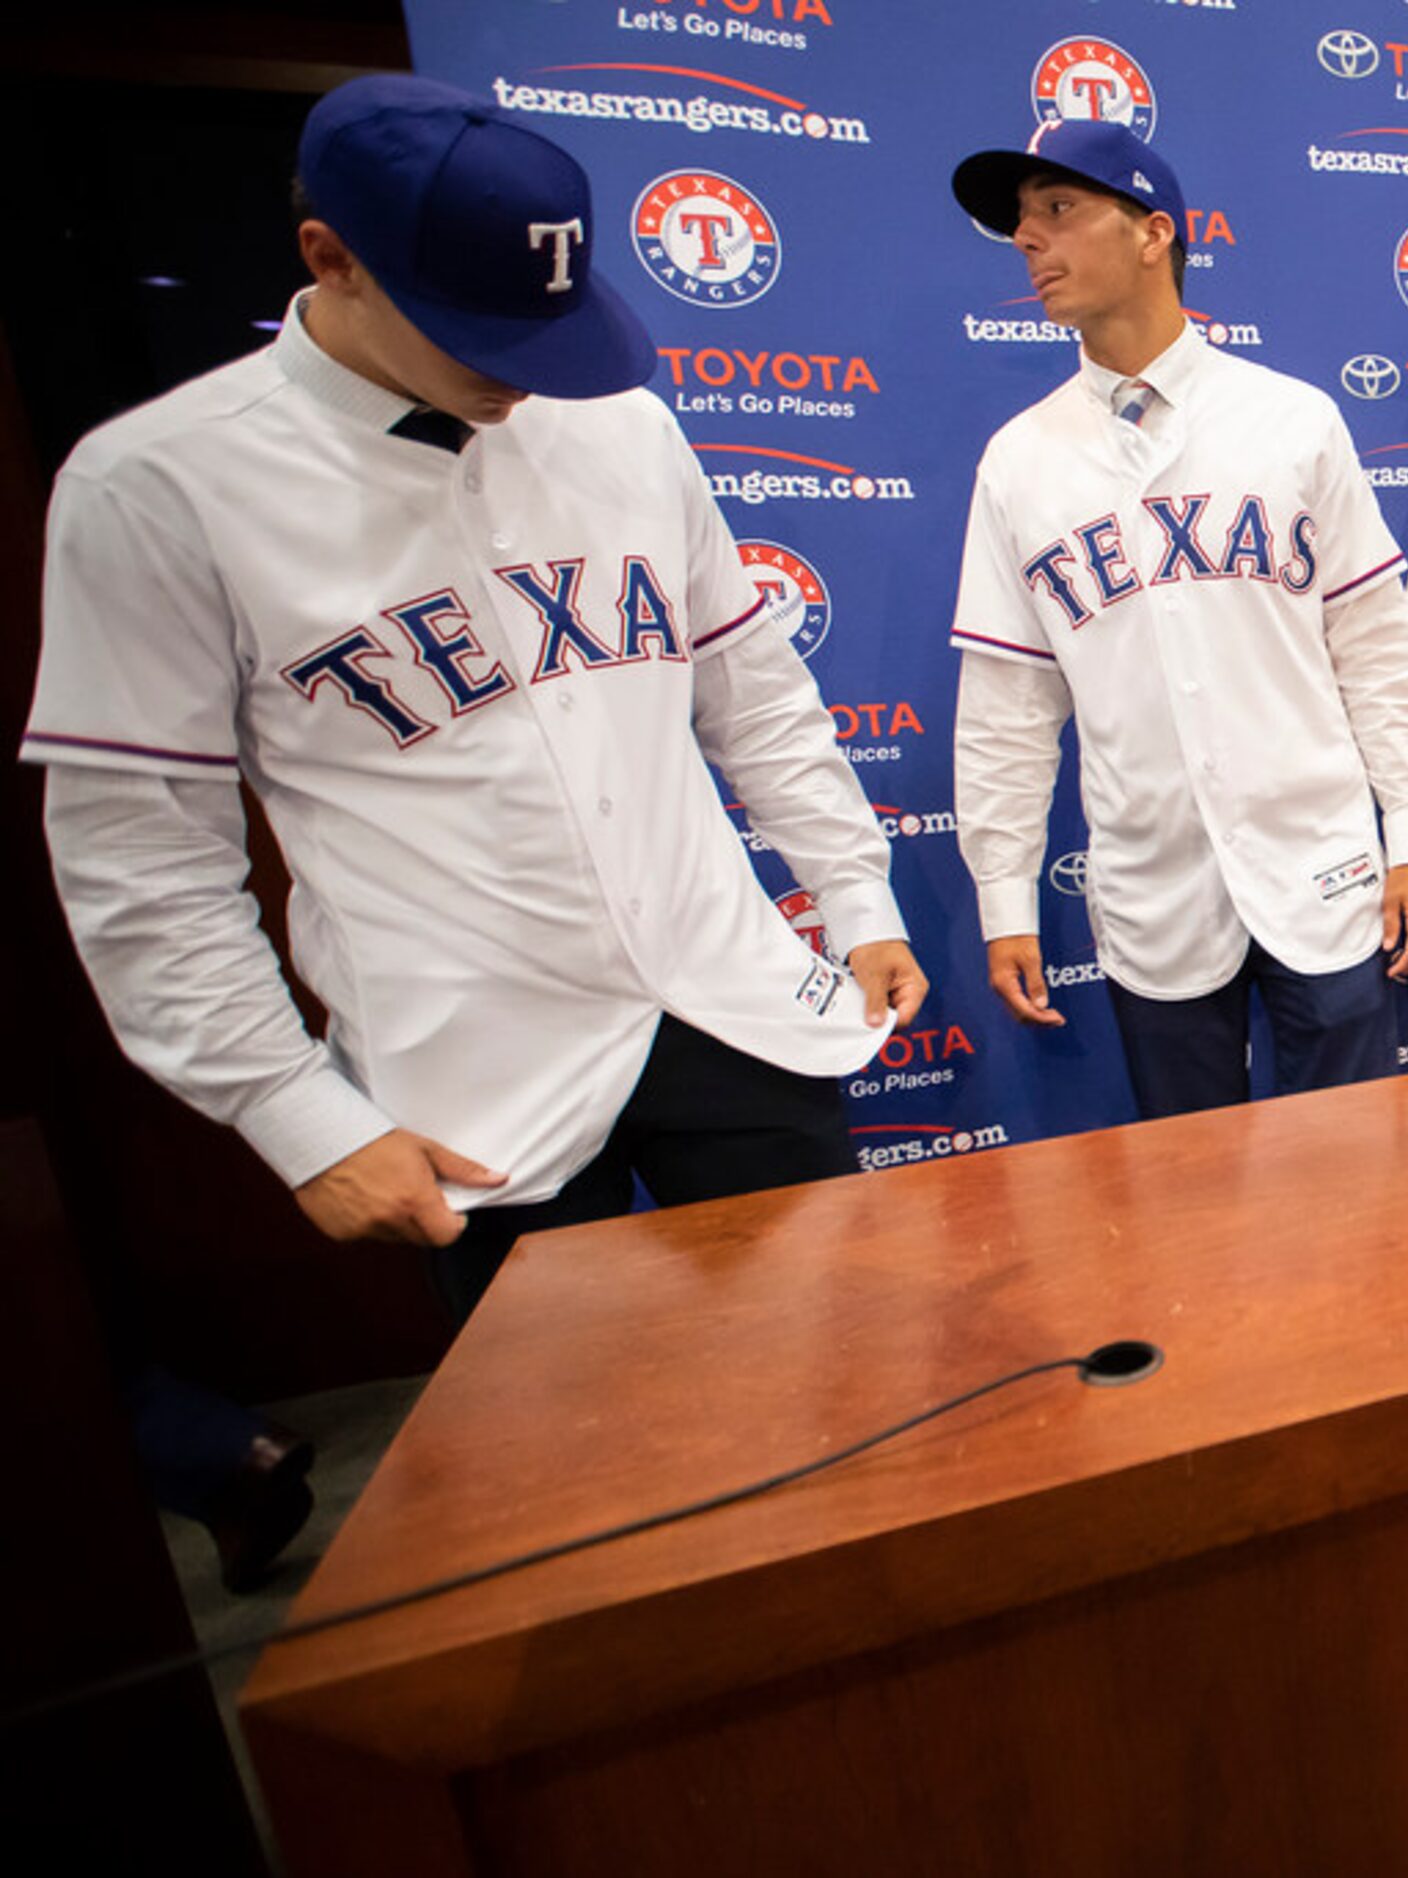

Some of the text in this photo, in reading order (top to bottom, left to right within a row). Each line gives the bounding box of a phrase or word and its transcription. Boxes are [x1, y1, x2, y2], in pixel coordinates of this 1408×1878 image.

[617, 7, 677, 32] Let's
[684, 13, 721, 37] Go
[725, 18, 808, 50] Places
[1047, 44, 1135, 79] TEXAS
[493, 75, 870, 144] texasrangers.com
[650, 178, 754, 217] TEXAS
[527, 217, 584, 294] T
[679, 213, 733, 270] T
[646, 246, 772, 301] RANGERS
[655, 347, 881, 394] TOYOTA
[676, 393, 856, 419] Let's Go Places
[703, 470, 915, 504] ngers.com
[1021, 493, 1319, 631] TEXAS
[279, 554, 692, 752] TEXA
[826, 702, 925, 740] OTA
[868, 1025, 976, 1071] OTA
[849, 1067, 955, 1099] Go Places
